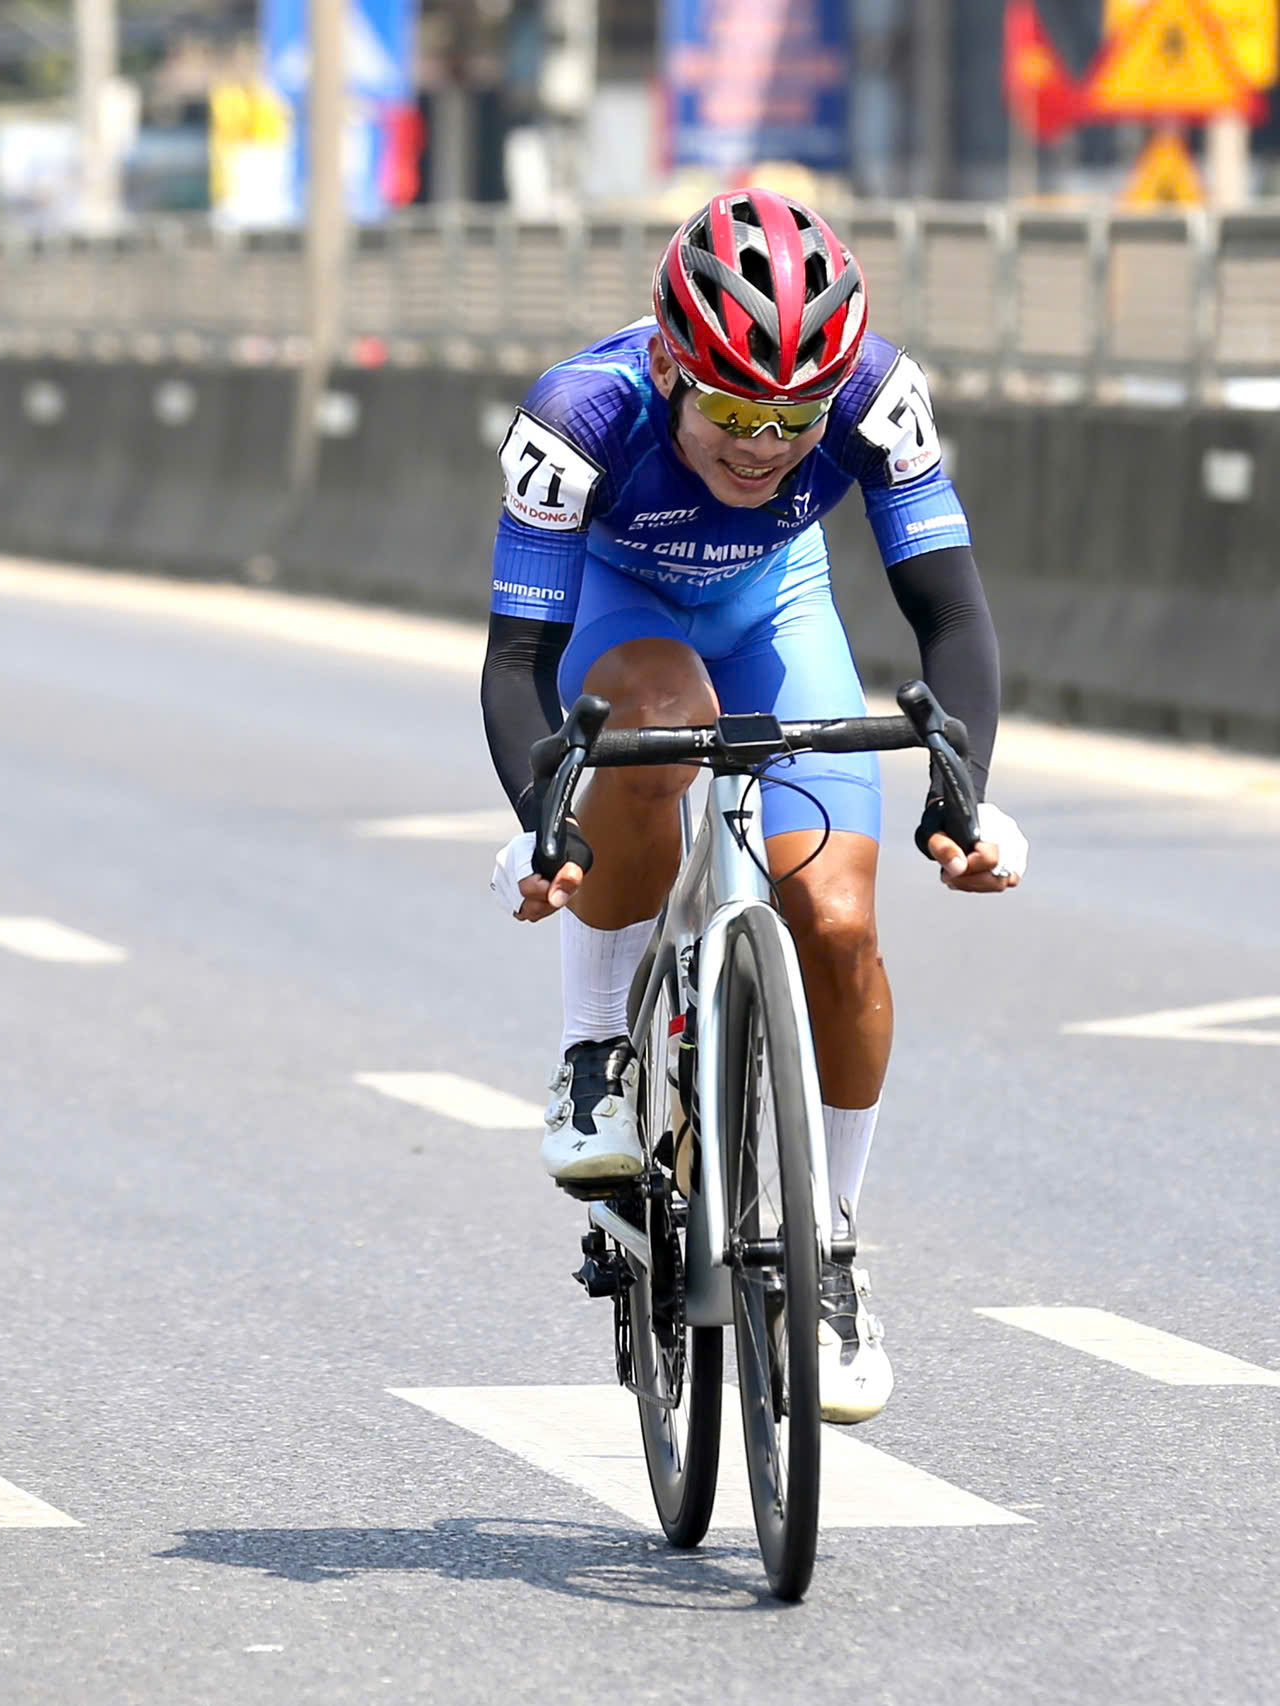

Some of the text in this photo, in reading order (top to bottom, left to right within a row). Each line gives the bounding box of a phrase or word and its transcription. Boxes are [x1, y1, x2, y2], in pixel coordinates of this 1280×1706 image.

[517, 441, 566, 508] 71
[633, 505, 700, 523] GIANT
[702, 543, 764, 562] MINH
[493, 579, 565, 601] SHIMANO
